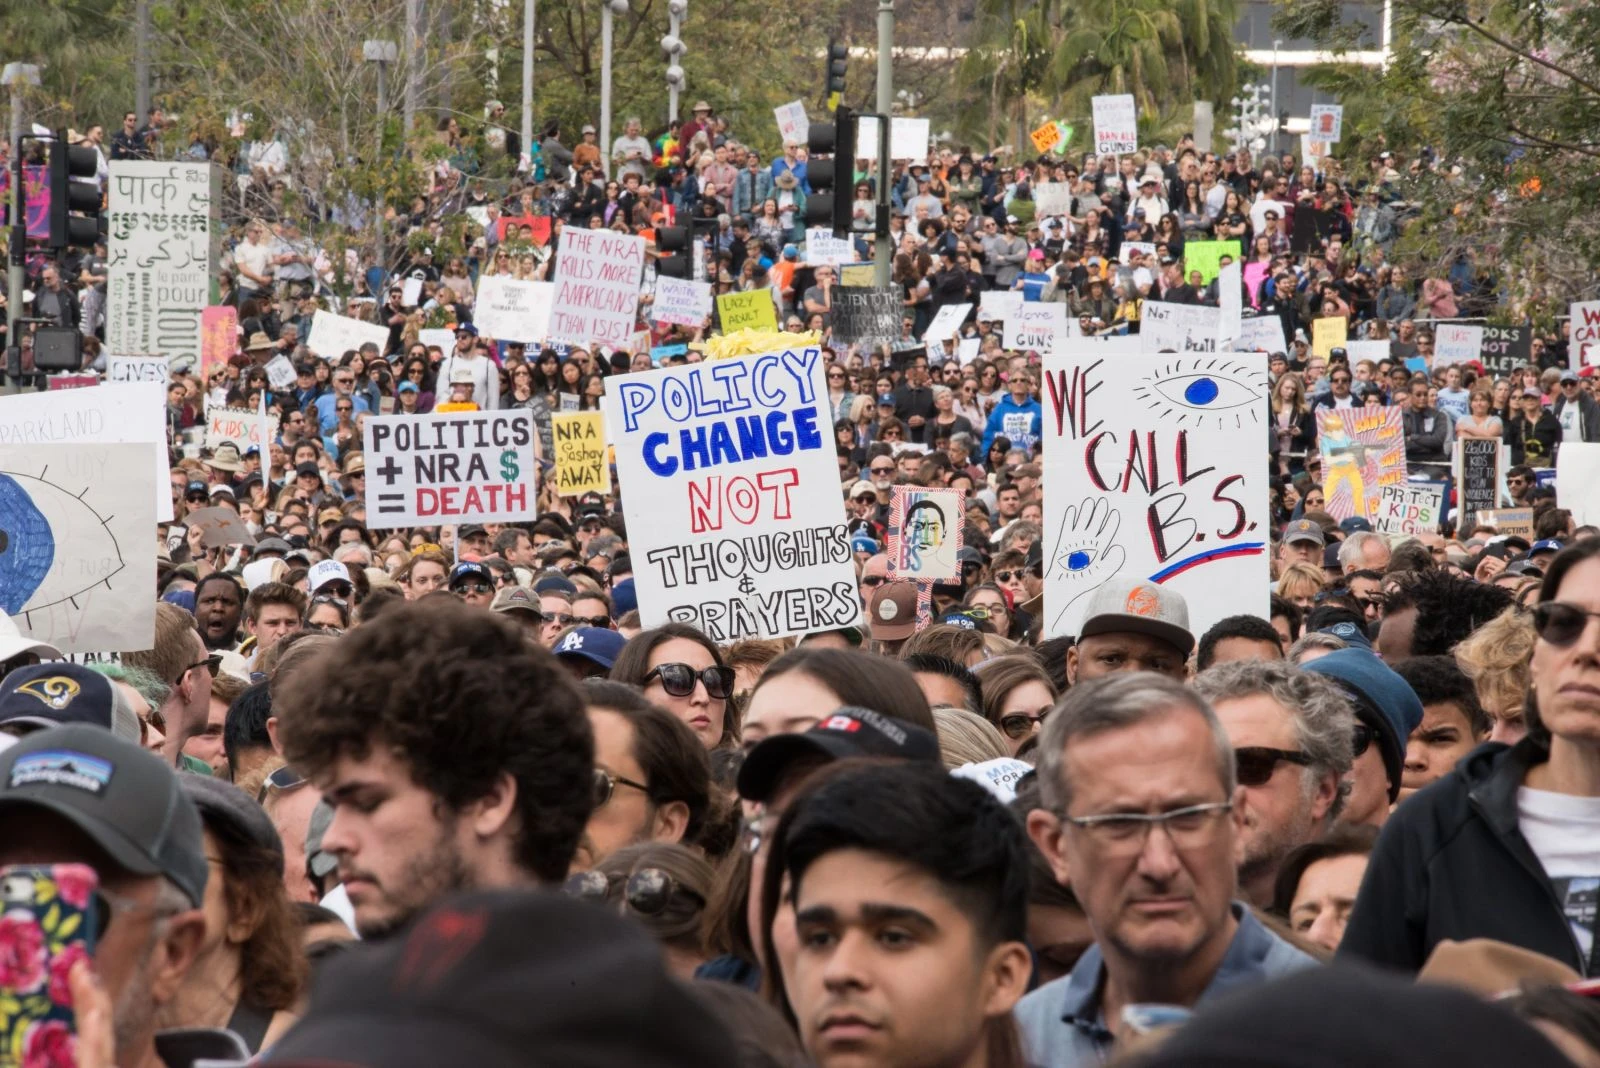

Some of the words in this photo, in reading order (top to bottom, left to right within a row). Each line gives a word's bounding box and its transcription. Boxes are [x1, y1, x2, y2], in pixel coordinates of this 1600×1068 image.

[1099, 142, 1134, 153] GUNS
[565, 231, 594, 254] THE
[599, 238, 641, 264] NRA
[560, 255, 593, 280] KILLS
[597, 262, 636, 285] MORE
[157, 286, 206, 306] pour
[557, 280, 637, 315] AMERICANS
[723, 295, 753, 311] LAZY
[870, 293, 880, 305] TO
[554, 311, 587, 334] THAN
[1581, 306, 1600, 326] W
[1016, 334, 1053, 348] GUNS
[1483, 328, 1520, 341] OOKS
[113, 362, 168, 384] LIVES
[1484, 356, 1528, 371] LLETS
[619, 349, 818, 432] POLICY
[1045, 359, 1104, 440] WE
[0, 408, 104, 444] PARKLAND
[372, 417, 530, 452] POLITICS
[556, 421, 596, 441] NRA
[558, 441, 604, 466] Sashay
[642, 406, 822, 477] CHANGE
[1464, 440, 1496, 454] 26,000
[414, 452, 490, 483] NRA
[1085, 429, 1216, 496] CALL
[560, 464, 603, 487] AWAY
[416, 483, 526, 516] DEATH
[688, 468, 799, 533] NOT
[1147, 474, 1258, 563] B.S.
[1389, 503, 1430, 522] KIDS
[647, 525, 851, 588] THOUGHTS
[899, 543, 922, 572] BS
[667, 581, 858, 641] PRAYERS
[562, 631, 584, 651] LA
[993, 771, 1019, 786] FOR
